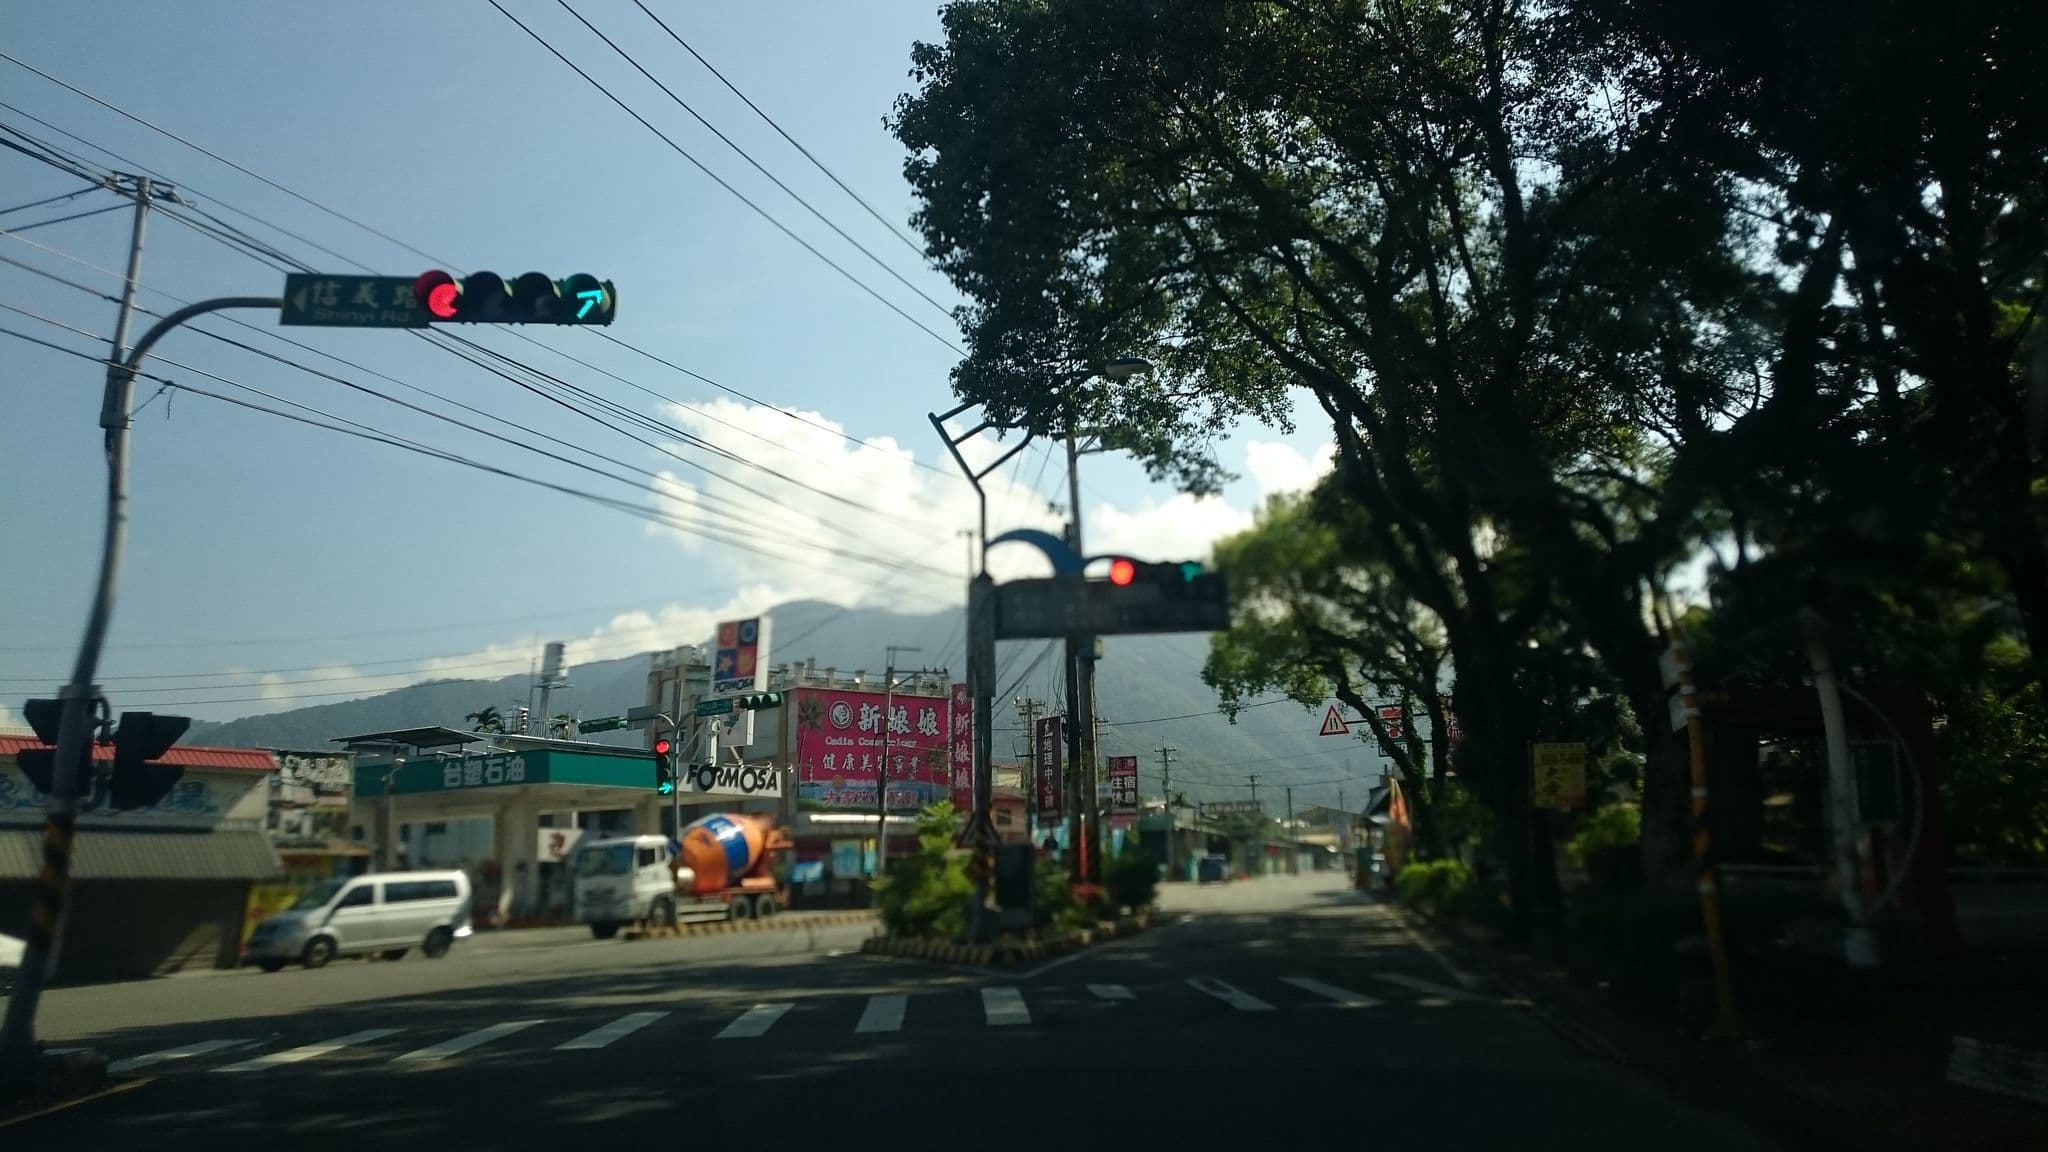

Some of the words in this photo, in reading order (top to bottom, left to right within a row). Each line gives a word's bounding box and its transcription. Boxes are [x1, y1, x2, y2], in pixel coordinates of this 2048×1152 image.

[312, 280, 418, 309] 信義路
[713, 678, 754, 692] FORMOSA
[443, 755, 524, 787] 台塑石油
[686, 764, 777, 793] FORMOSA
[1111, 776, 1136, 789] 住宿
